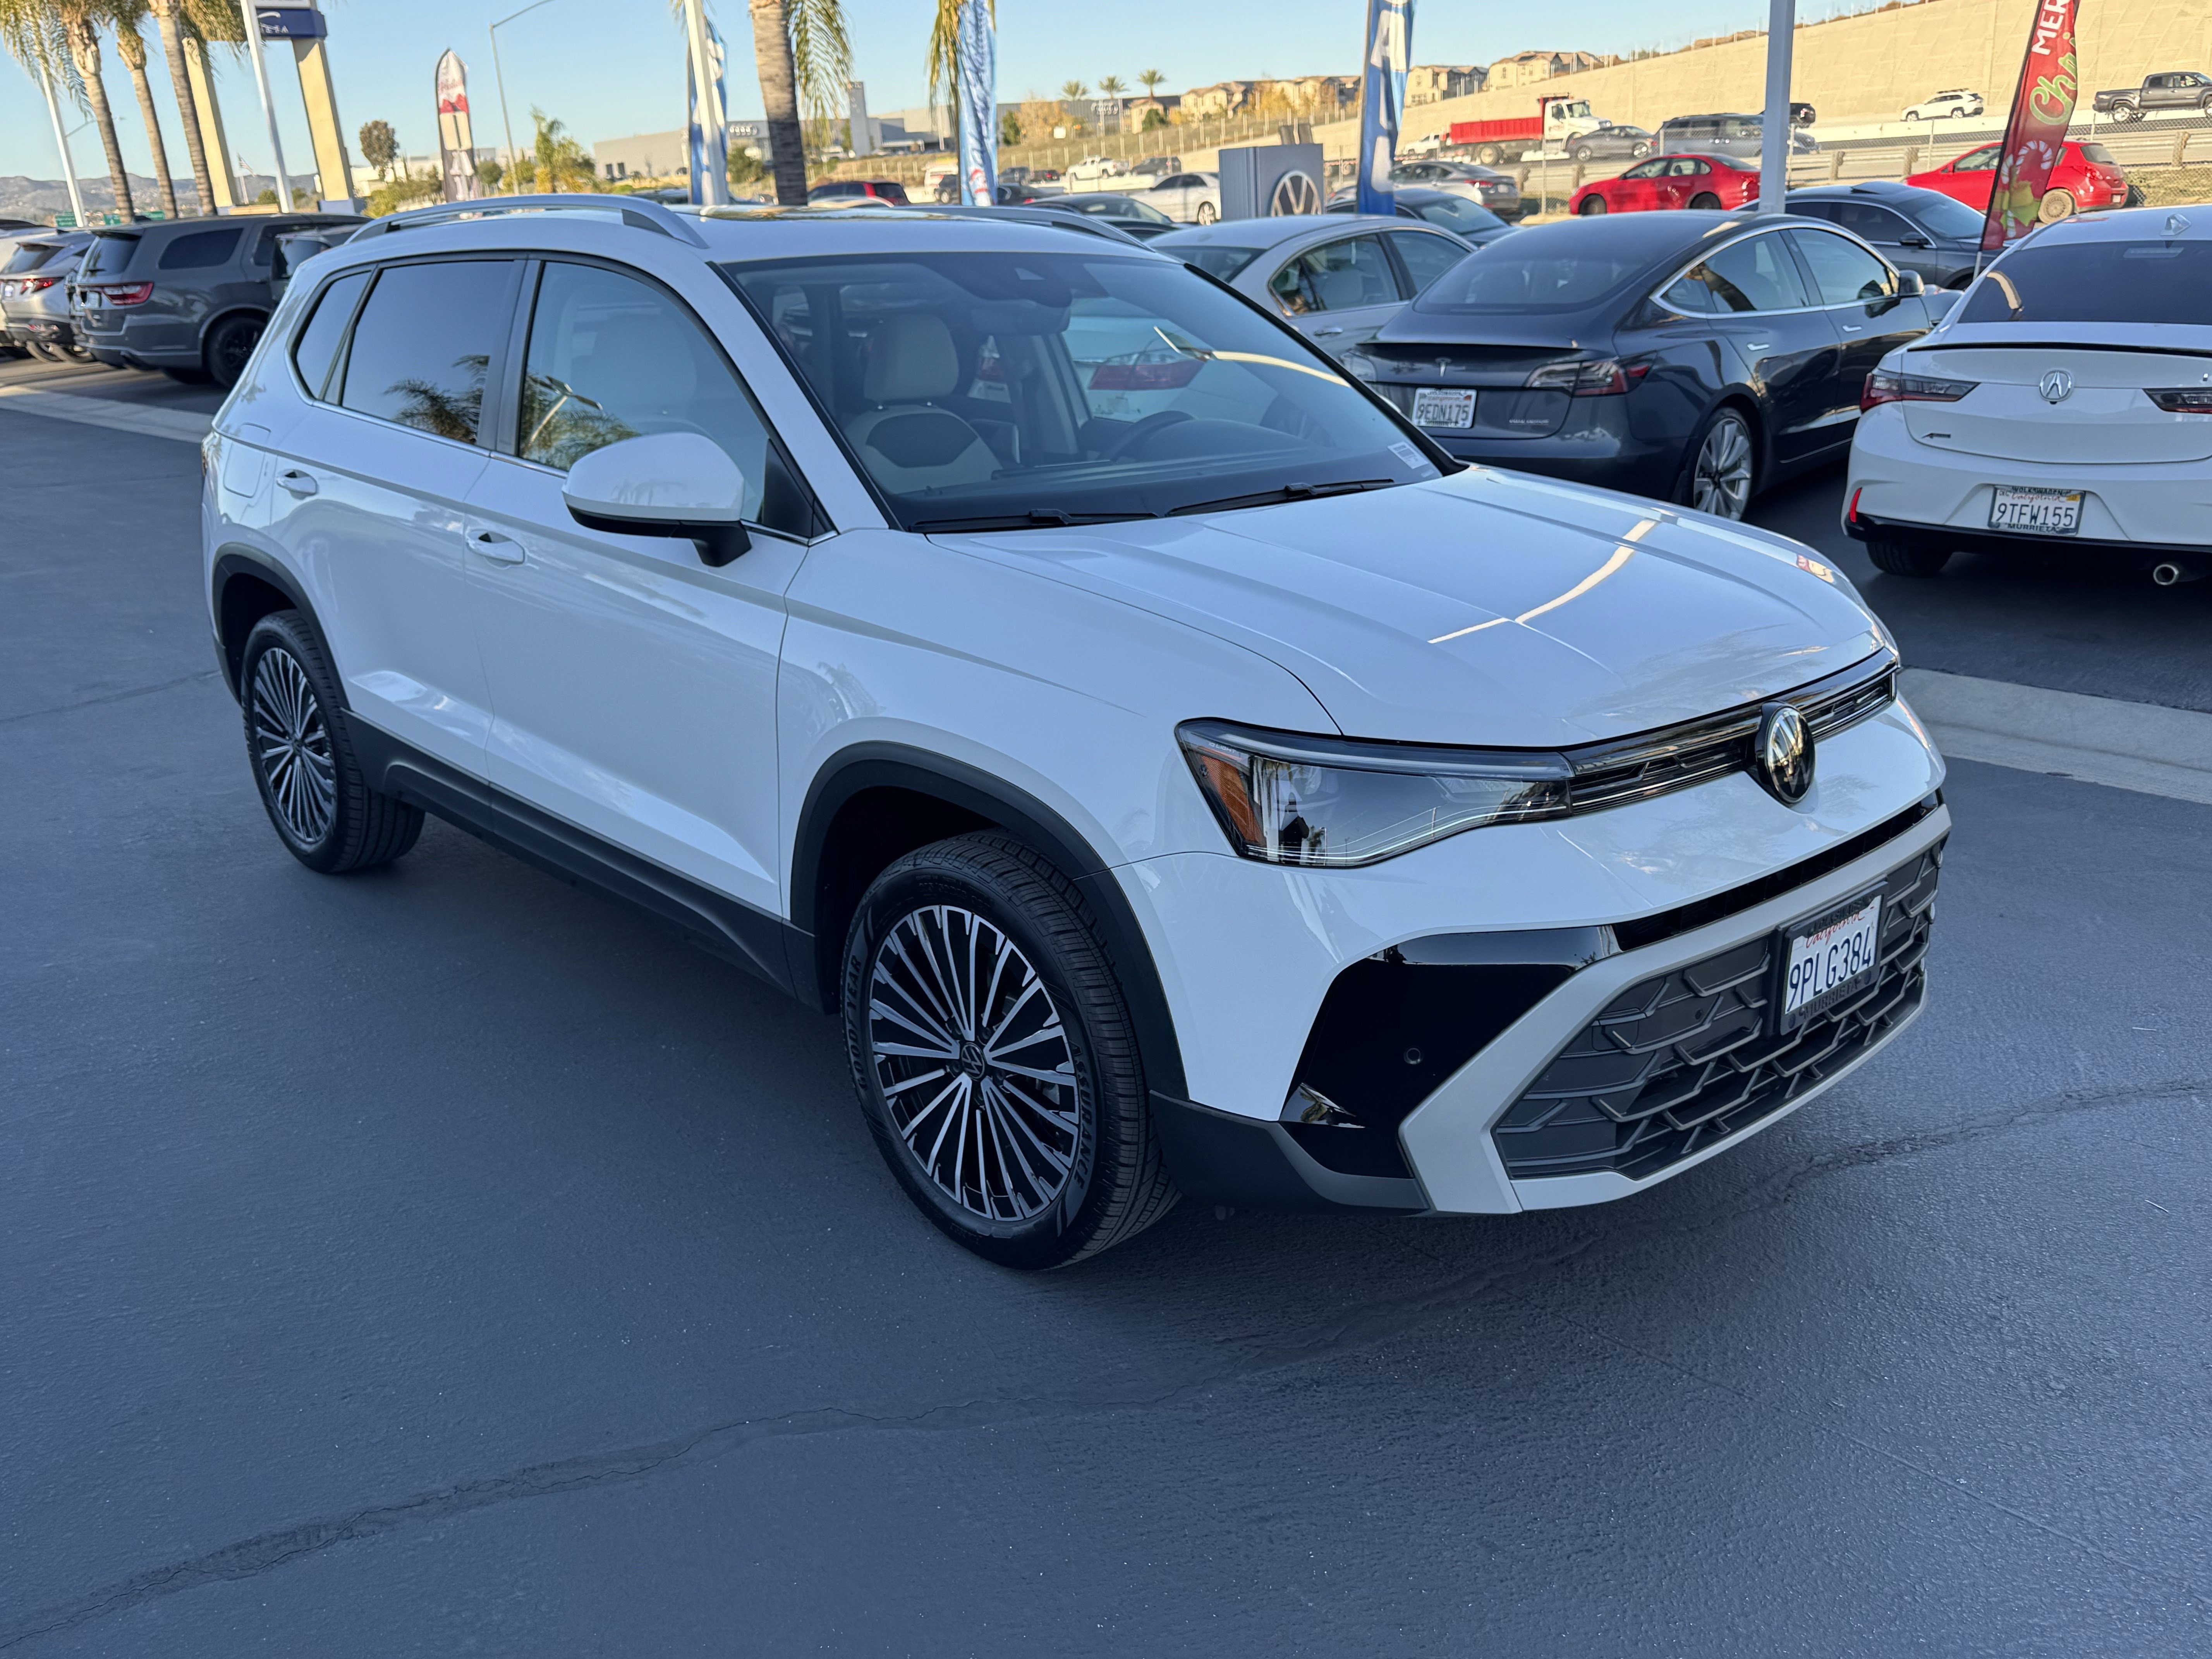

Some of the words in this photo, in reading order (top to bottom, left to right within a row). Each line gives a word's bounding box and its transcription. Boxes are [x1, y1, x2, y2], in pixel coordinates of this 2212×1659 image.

[1996, 503, 2074, 527] 9TFW155
[2008, 523, 2057, 532] MURRIETA
[1787, 925, 1871, 1012] 9PLG384
[1069, 1040, 1092, 1189] ASSURANCE
